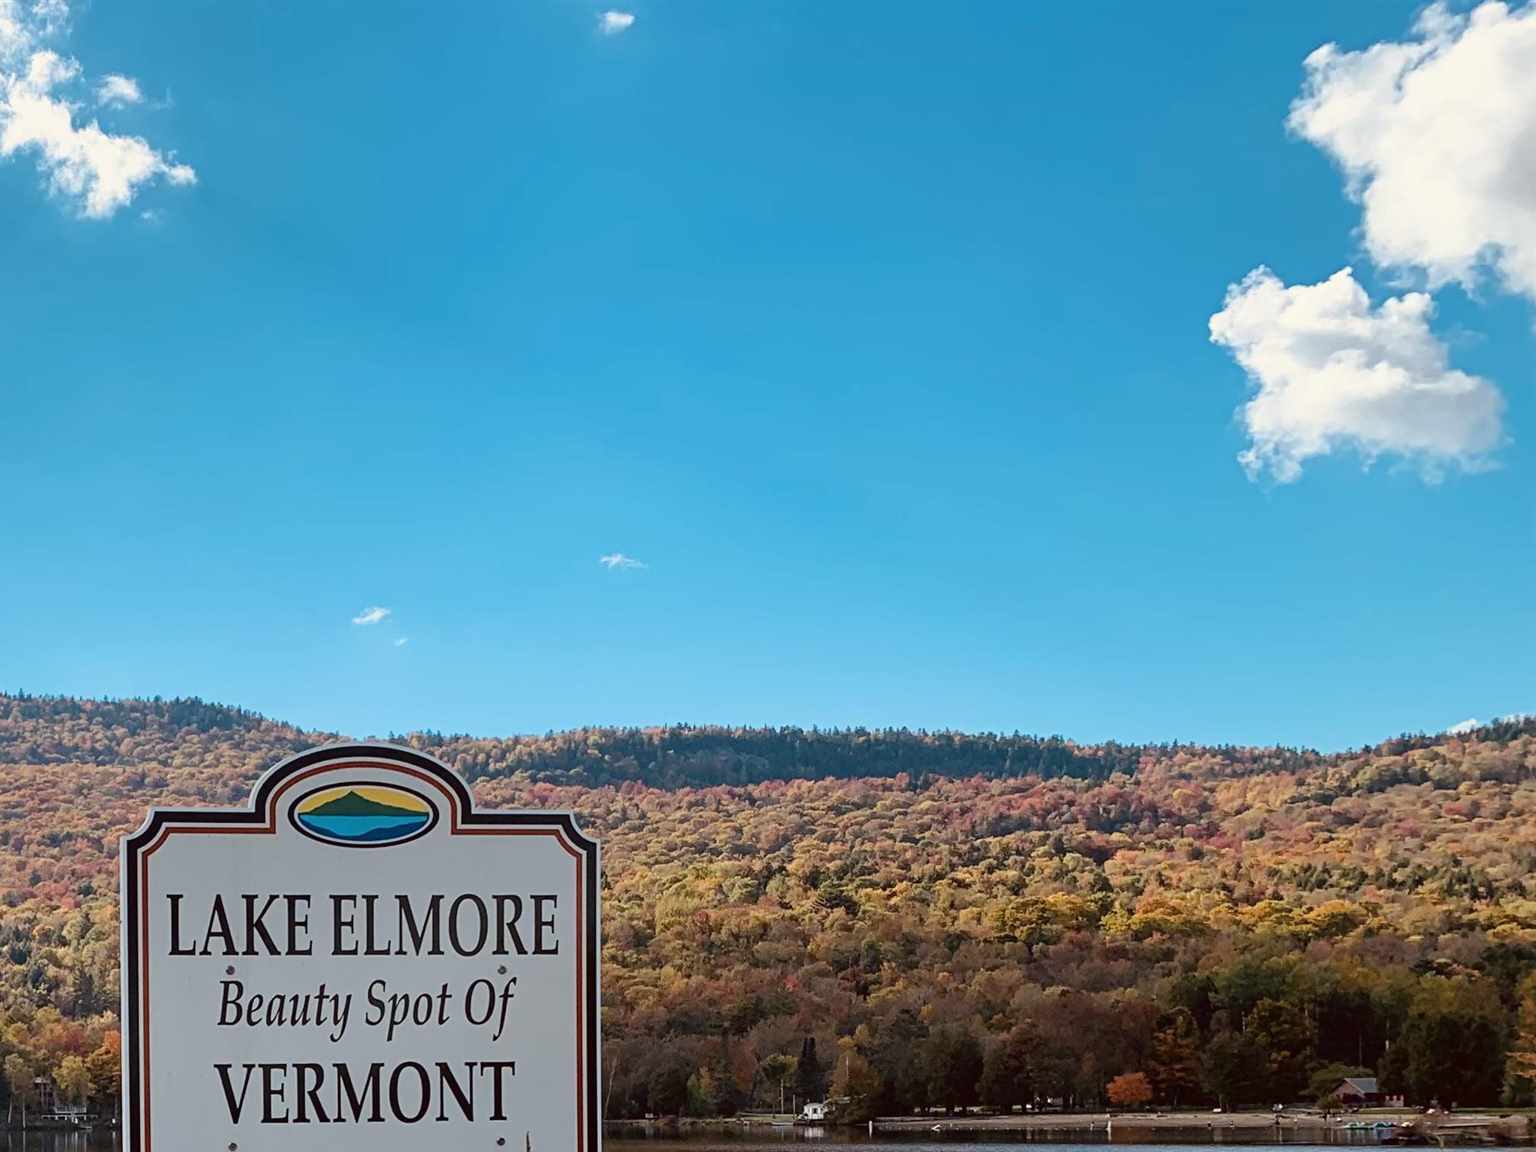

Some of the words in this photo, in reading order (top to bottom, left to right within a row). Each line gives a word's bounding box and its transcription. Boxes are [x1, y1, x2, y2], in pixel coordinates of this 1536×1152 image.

[167, 894, 313, 956] LAKE
[329, 894, 559, 956] ELMORE
[217, 979, 353, 1042] Beauty
[365, 979, 453, 1042] Spot
[465, 976, 518, 1041] Of
[214, 1061, 516, 1124] VERMONT
